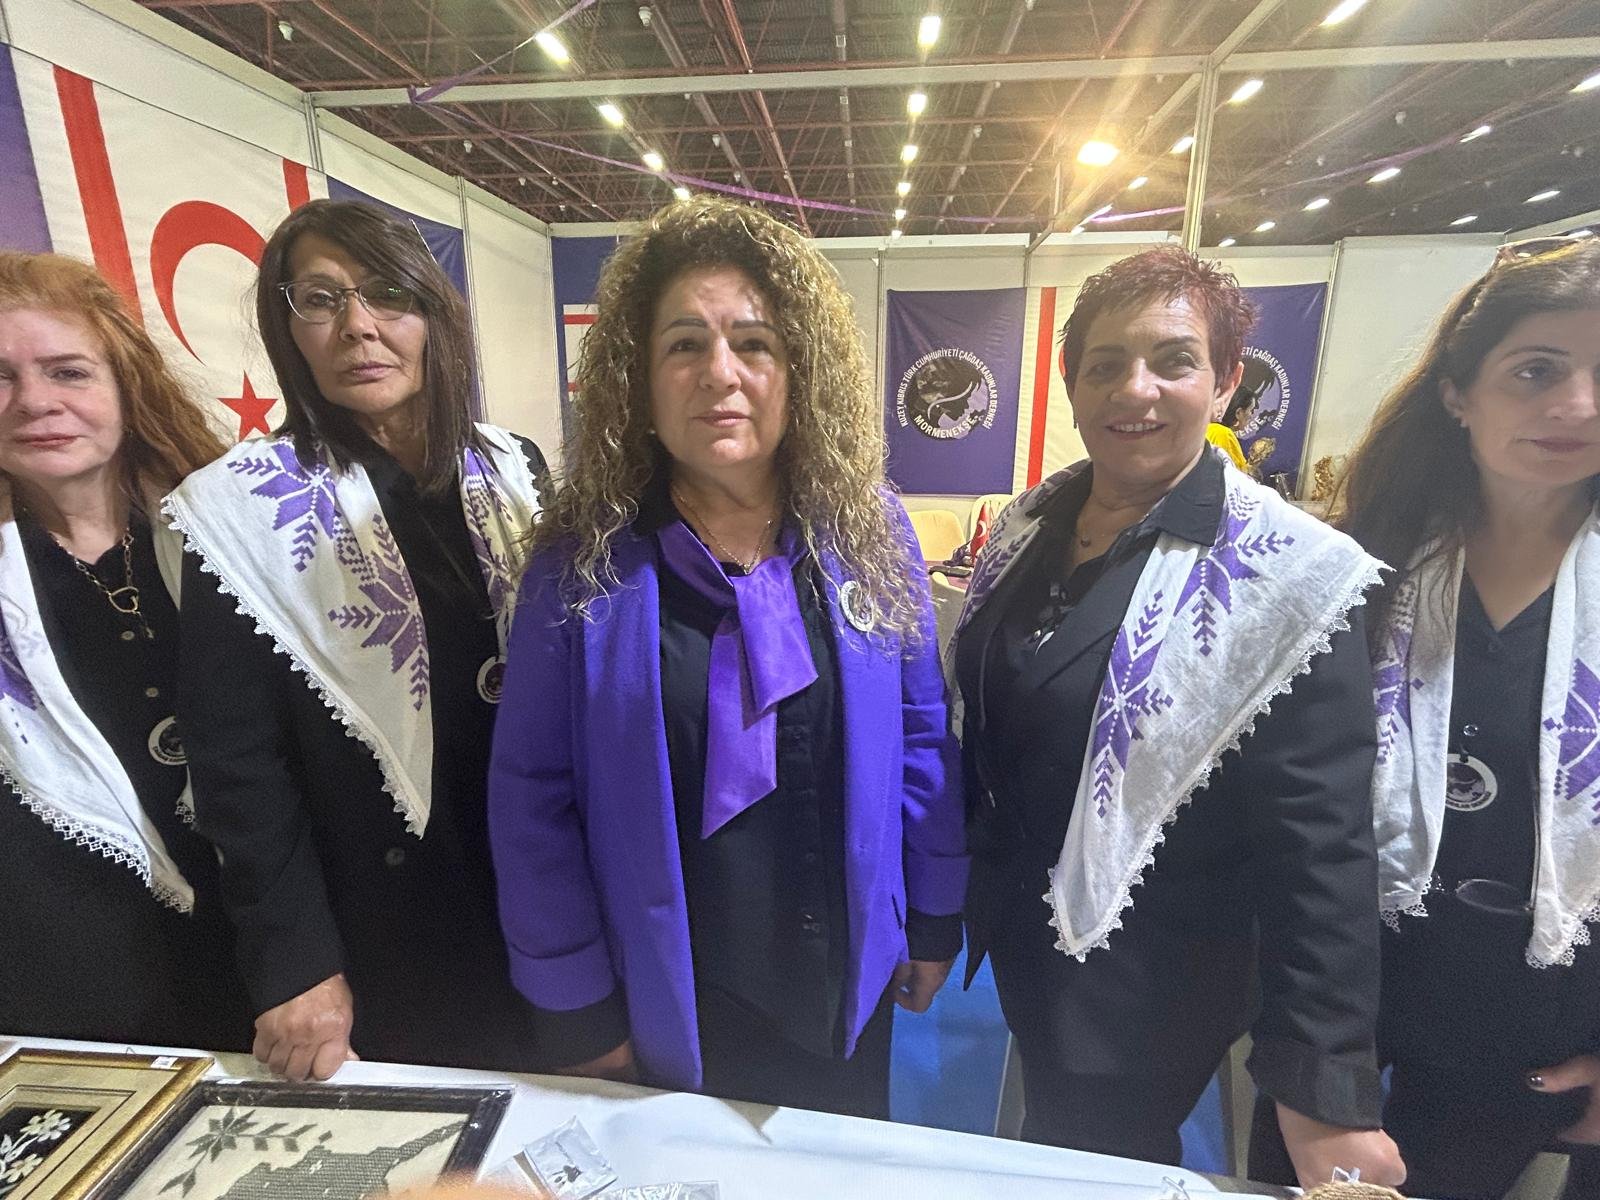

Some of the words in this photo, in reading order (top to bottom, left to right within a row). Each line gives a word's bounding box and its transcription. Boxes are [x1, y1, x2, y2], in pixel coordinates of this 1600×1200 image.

[916, 347, 959, 369] CUMHURİYETİ
[958, 350, 984, 370] ÇAĞDAŞ
[1252, 348, 1279, 369] ÇAĞDAŞ
[902, 367, 918, 383] TÜRK
[981, 365, 998, 401] KADINLAR
[1274, 364, 1291, 399] KADINLAR
[914, 414, 976, 438] MORMENEKŞE
[982, 400, 998, 430] DERNEĞİ
[1271, 400, 1290, 430] DERNEĞİ
